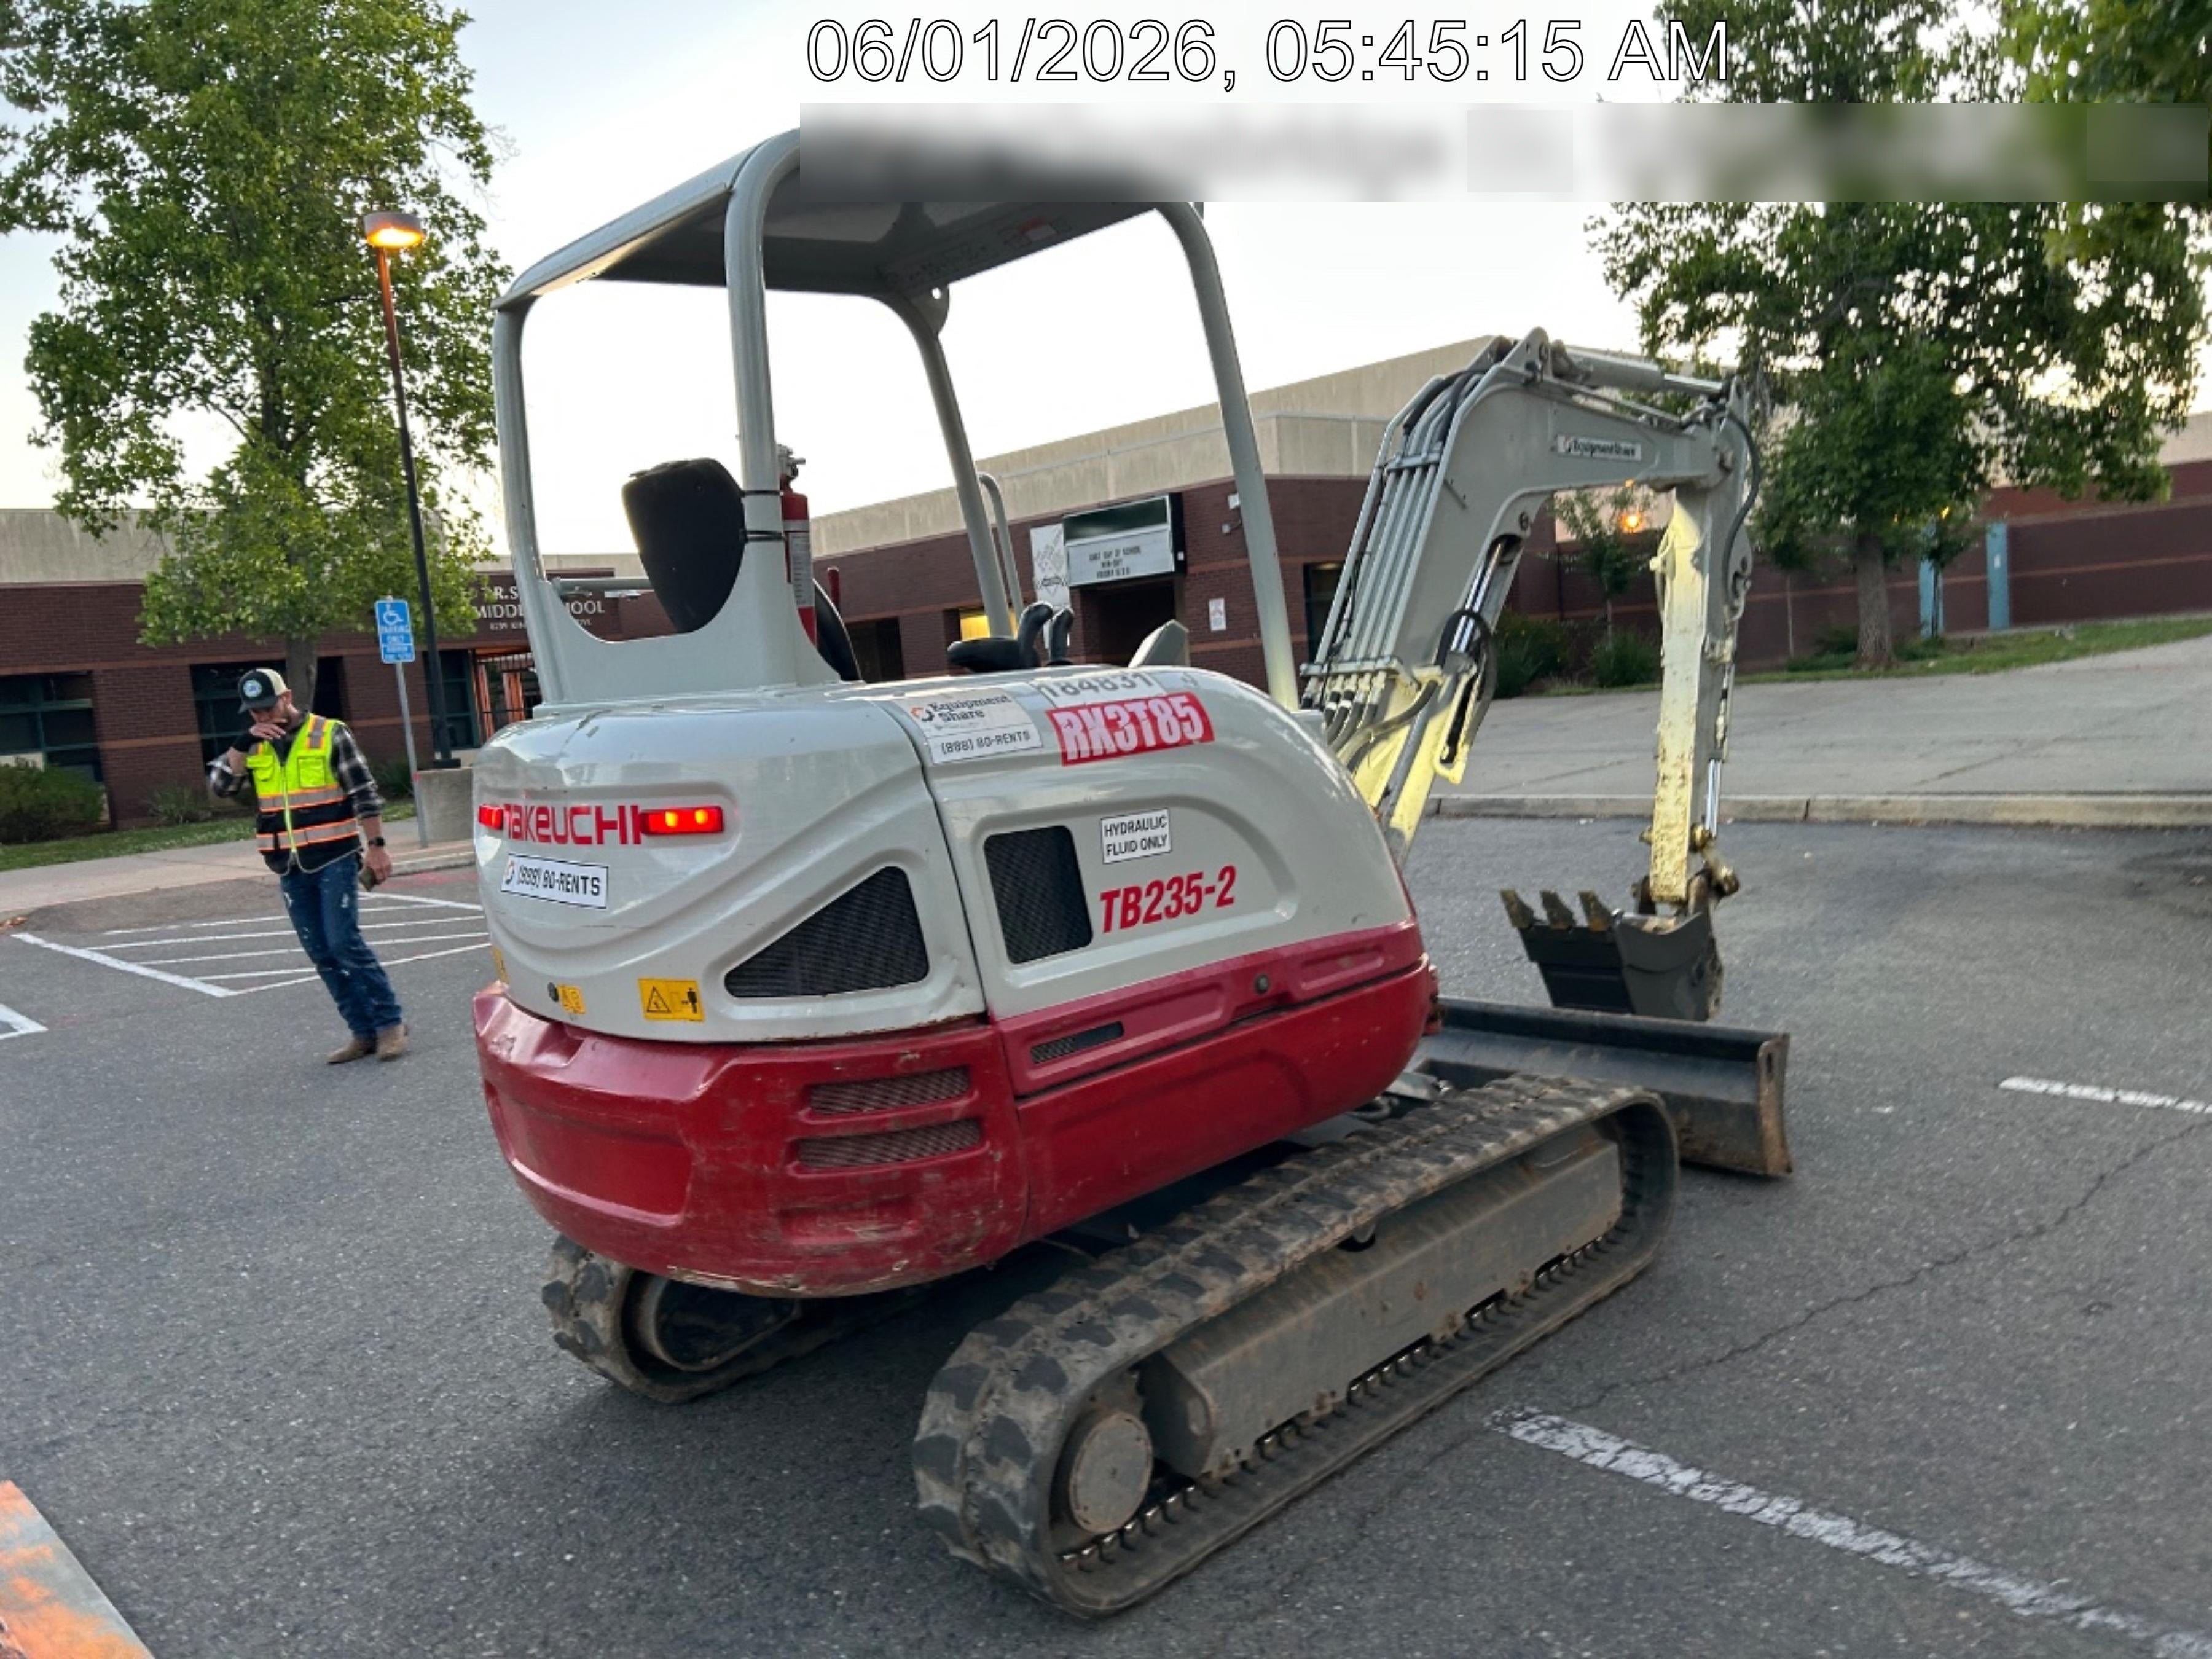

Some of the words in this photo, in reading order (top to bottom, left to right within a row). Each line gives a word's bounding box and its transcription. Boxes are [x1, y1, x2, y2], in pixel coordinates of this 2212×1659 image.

[479, 604, 523, 618] MIDDL
[565, 600, 605, 614] OOL
[928, 694, 1013, 713] Equipment
[938, 710, 986, 722] Share
[1051, 694, 1204, 761] RX3T85
[1104, 815, 1167, 837] HYDRAULIC
[1107, 839, 1137, 856] FLUID
[1140, 834, 1167, 851] ONLY
[1099, 864, 1237, 933] TB235-2
